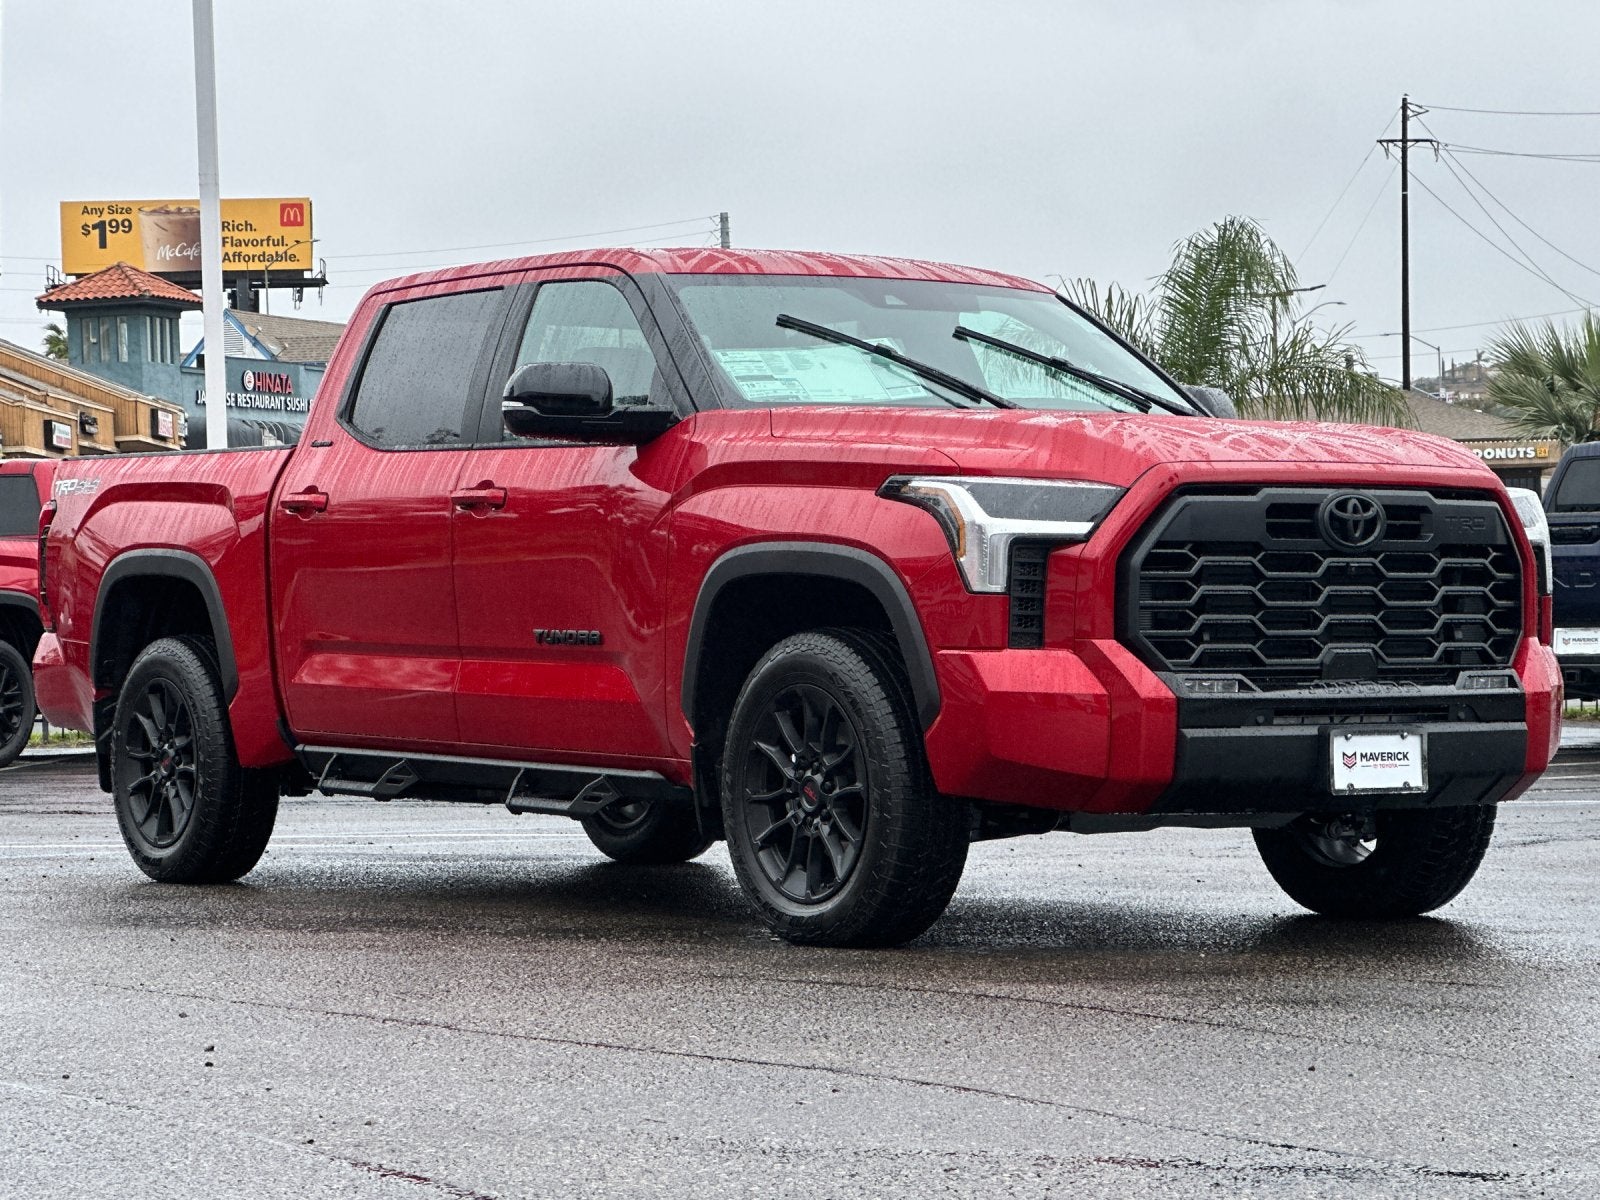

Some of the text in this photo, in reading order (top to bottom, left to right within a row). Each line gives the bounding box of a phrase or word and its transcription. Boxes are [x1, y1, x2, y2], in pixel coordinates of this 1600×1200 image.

[81, 204, 133, 218] Any Size
[221, 220, 257, 232] Rich.
[221, 235, 289, 248] Flavorful.
[221, 251, 300, 263] Affordable.
[254, 371, 294, 395] HINATA
[197, 389, 235, 407] JASE
[237, 392, 285, 410] RESTAURANT
[286, 397, 308, 412] SUSHI
[1472, 446, 1536, 459] DONUTS
[532, 628, 602, 645] TUNDRA
[1360, 751, 1410, 762] MAVERICK
